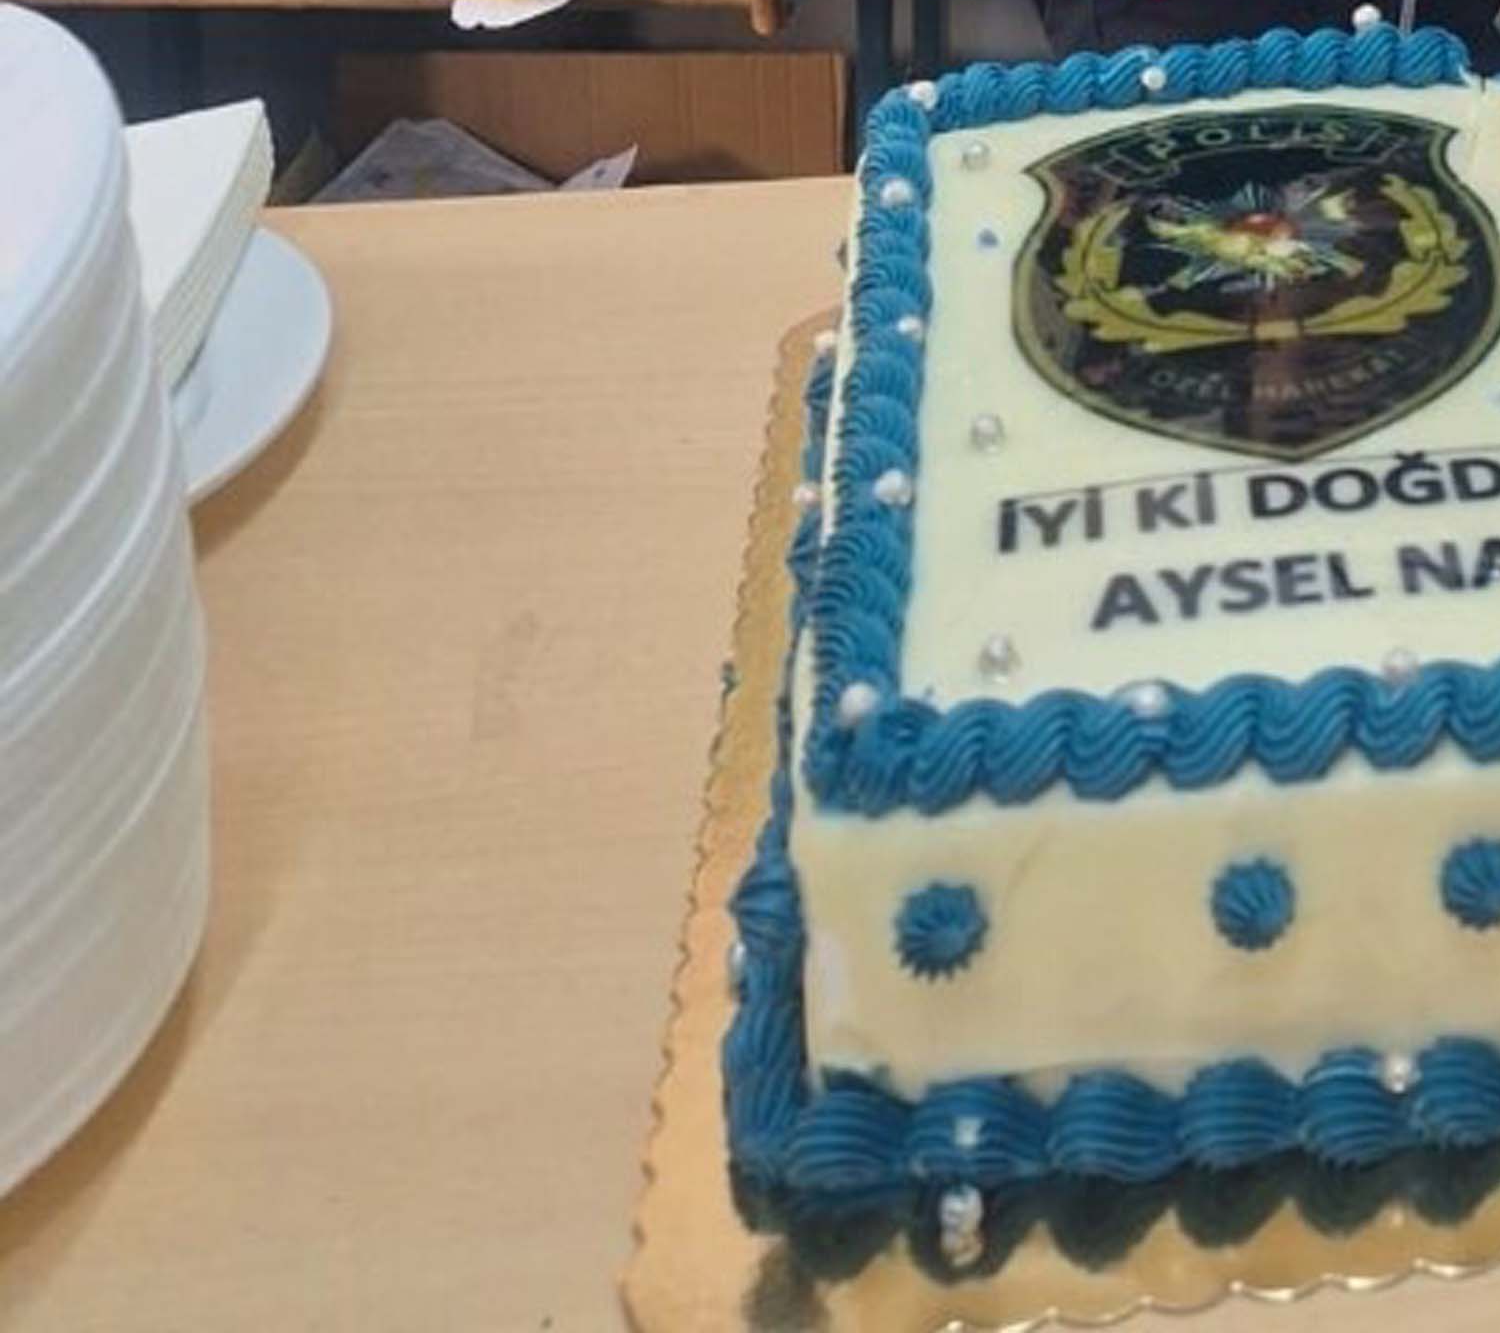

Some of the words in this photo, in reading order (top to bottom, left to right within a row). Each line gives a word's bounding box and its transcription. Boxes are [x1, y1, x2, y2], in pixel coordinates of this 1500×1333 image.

[998, 485, 1104, 553] İYİ
[1136, 471, 1216, 534] Kİ
[1090, 551, 1375, 630] AYSEL
